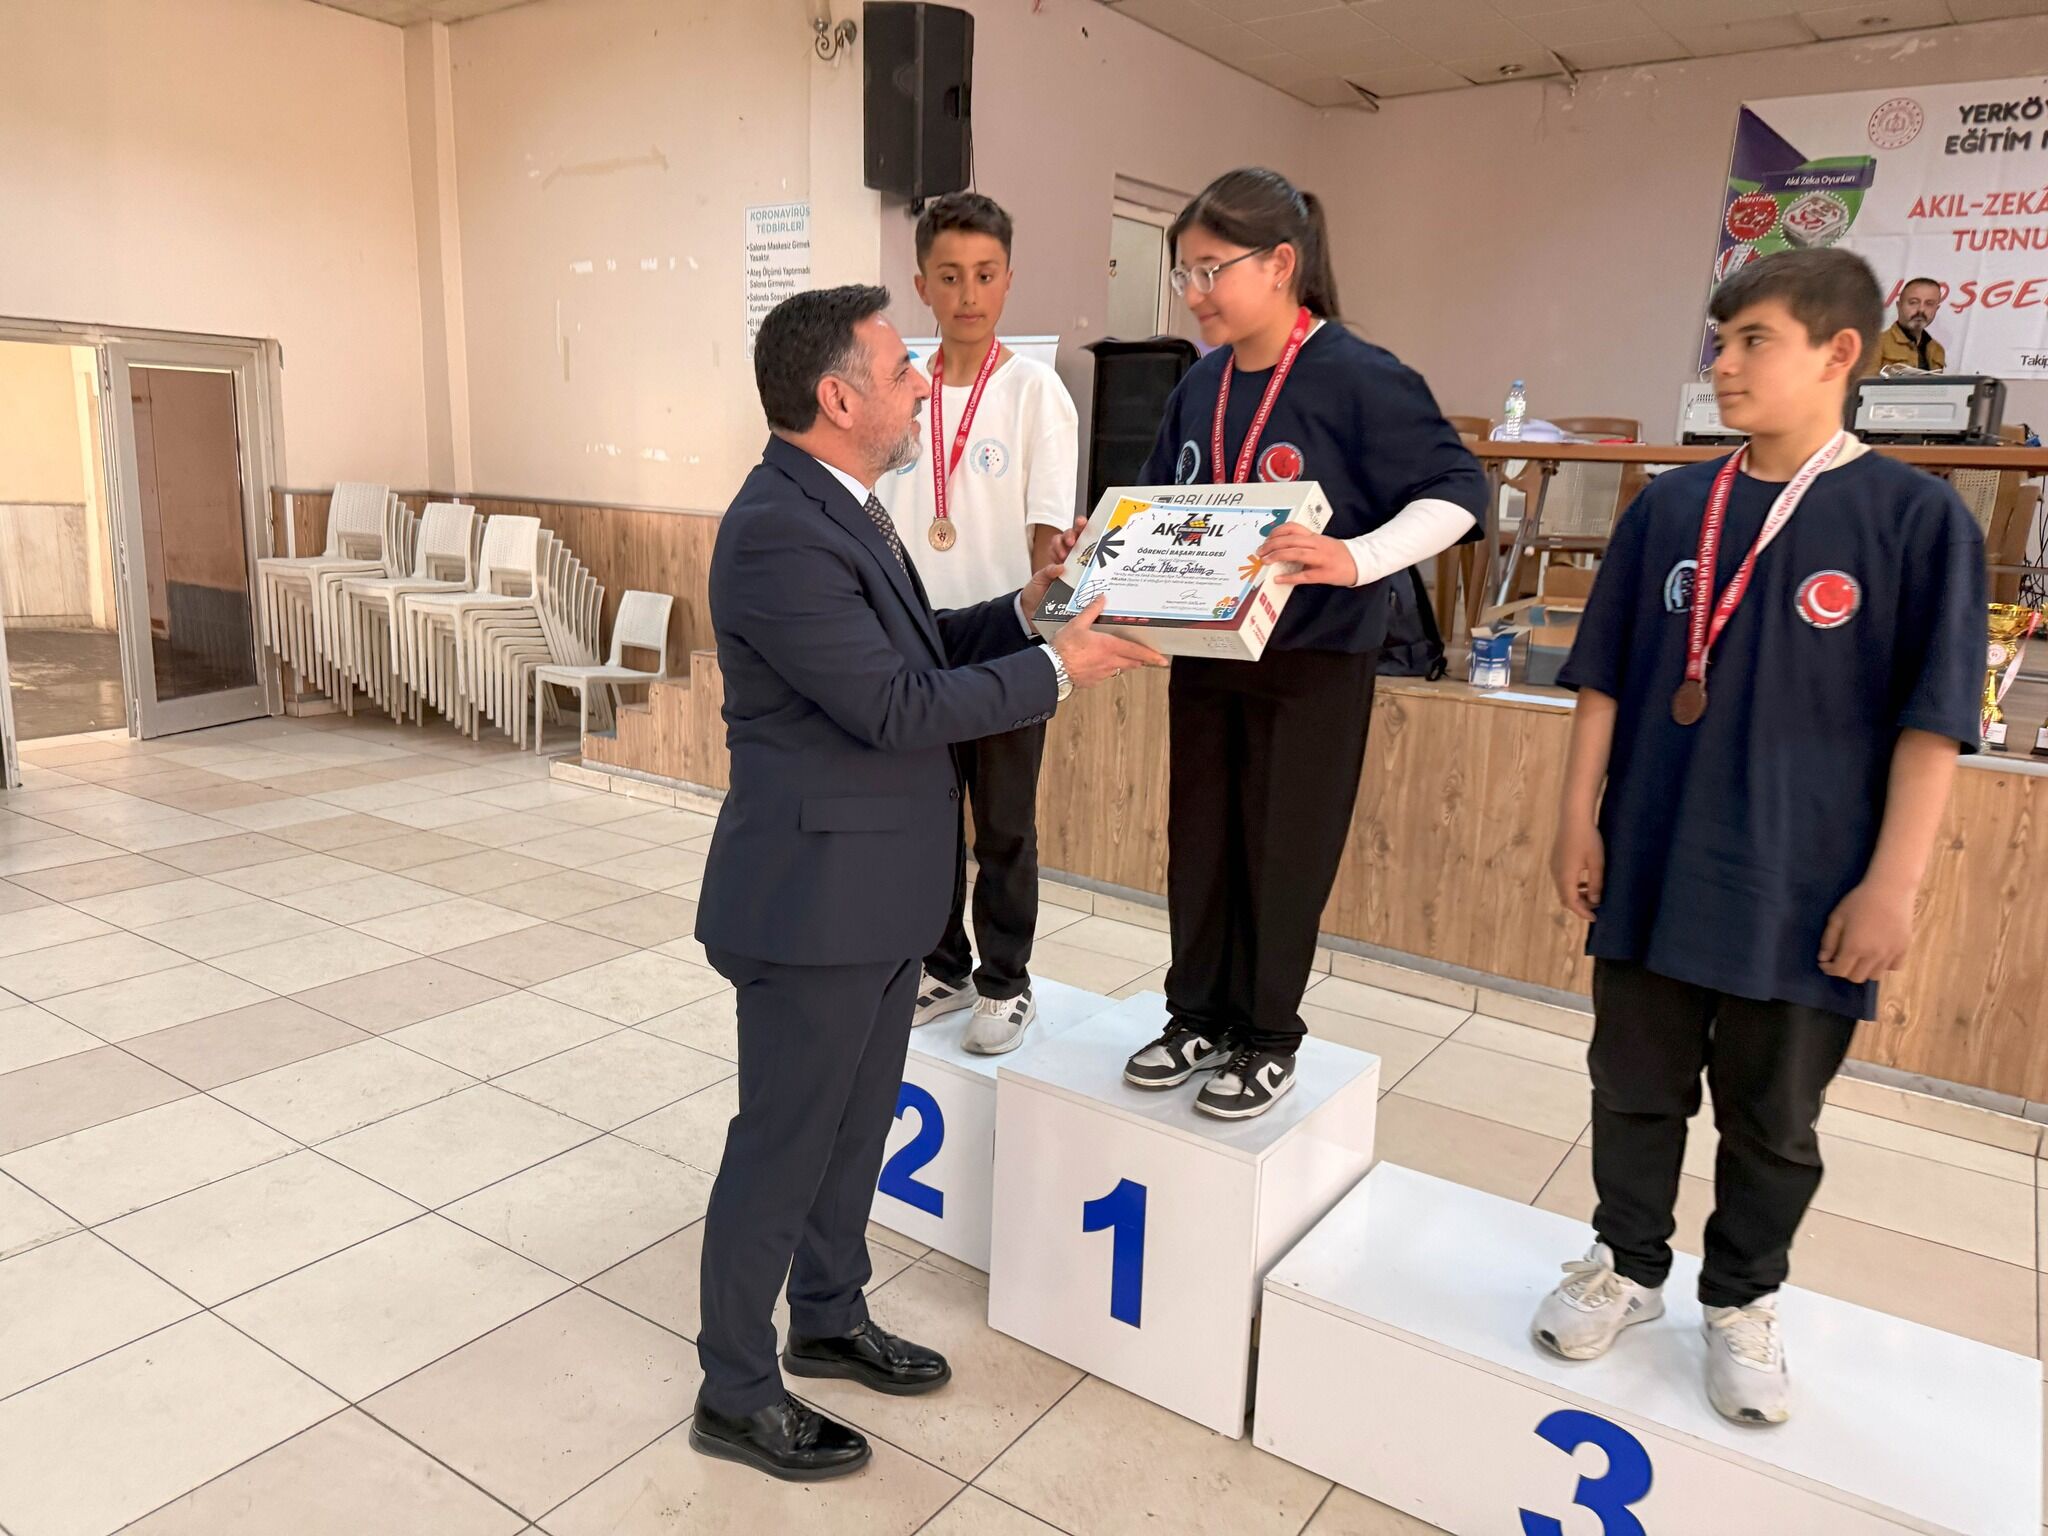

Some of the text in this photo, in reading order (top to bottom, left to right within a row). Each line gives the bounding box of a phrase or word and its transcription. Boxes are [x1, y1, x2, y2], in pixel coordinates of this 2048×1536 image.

[1959, 96, 2048, 125] YERKÖ
[1944, 126, 2032, 155] EĞİTİM
[750, 205, 811, 221] KORONAVİRÜS
[756, 220, 805, 234] TEDBİRLERİ
[749, 243, 767, 252] Salona
[767, 241, 791, 250] Maskesiz
[749, 280, 767, 289] Salona
[1279, 344, 1297, 373] TÜRKİYE
[1256, 374, 1282, 424] CUMHURİYETİ
[961, 407, 973, 432] TÜRKİYE
[1215, 391, 1225, 441] CUMHURİYETİ
[1243, 426, 1259, 457] GENÇLİK
[936, 468, 943, 477] VE
[1241, 458, 1250, 470] VE
[1137, 547, 1227, 558] ÖĞRENCİ BAŞARI BELGESİ
[1699, 528, 1714, 566] GENÇLİK
[1699, 566, 1710, 578] VE
[1696, 578, 1709, 603] SPOR
[1723, 571, 1743, 609] TÜRKİYE
[1691, 603, 1707, 654] BAKANLIĞI
[878, 1081, 945, 1219] 2
[1083, 1177, 1147, 1329] 1
[1519, 1409, 1653, 1536] 3
